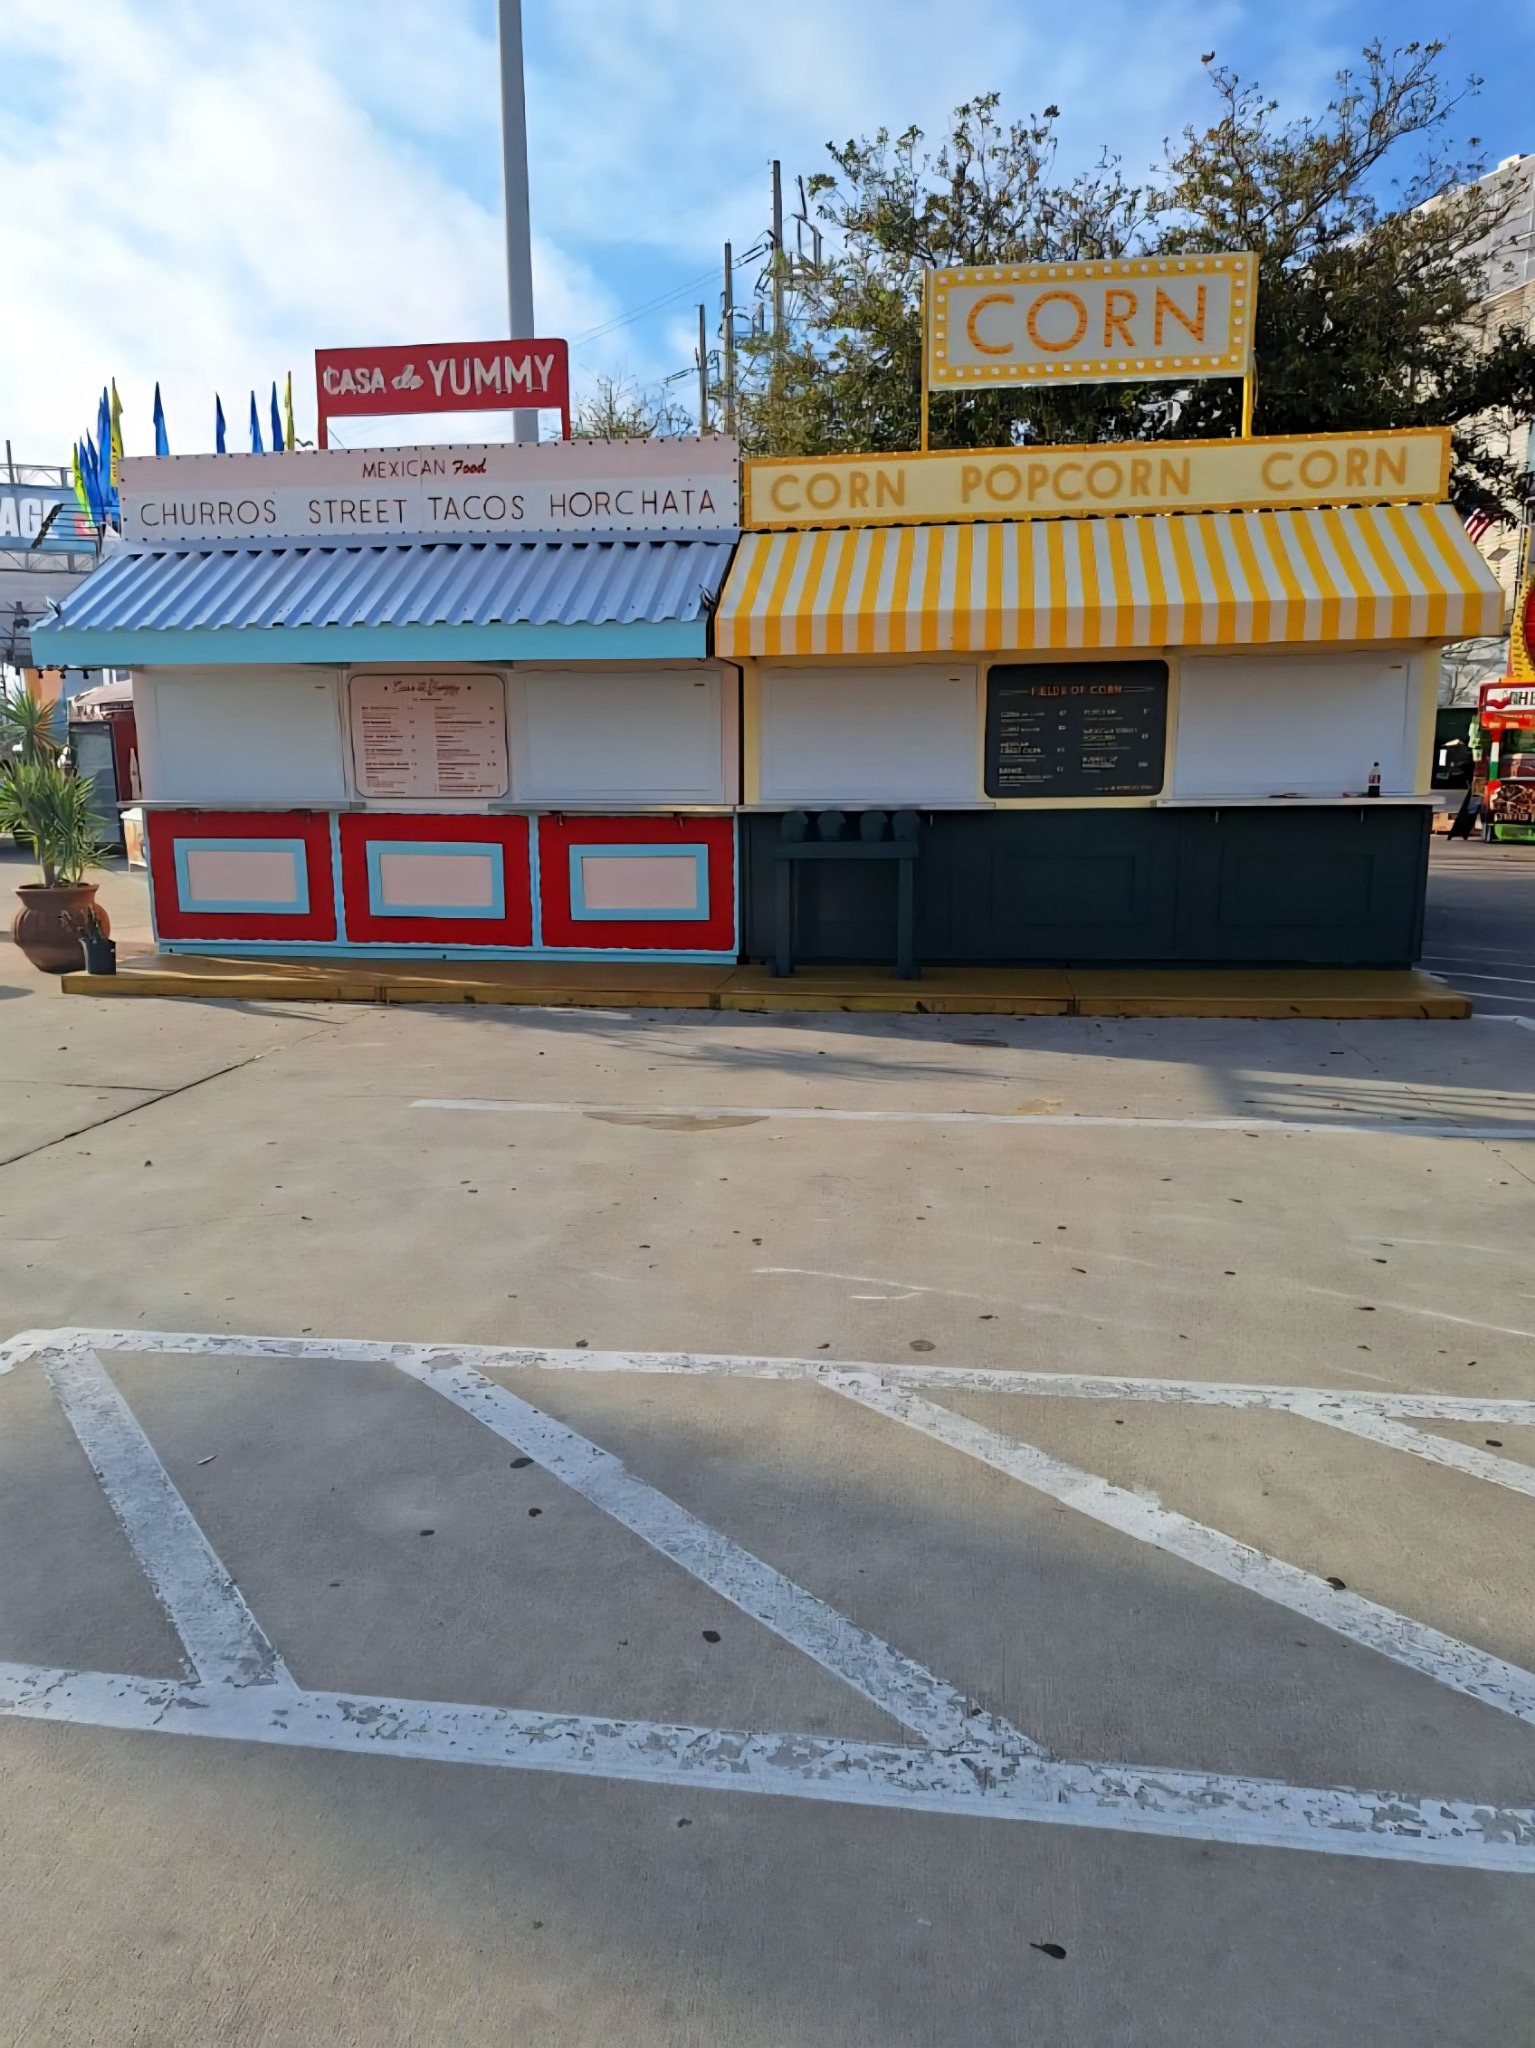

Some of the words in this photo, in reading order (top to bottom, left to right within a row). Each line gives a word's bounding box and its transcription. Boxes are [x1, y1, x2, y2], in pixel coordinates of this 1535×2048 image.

[967, 284, 1206, 355] CORN
[323, 351, 387, 395] CASA
[427, 354, 555, 397] YUMMY
[362, 459, 446, 478] MEXICAN
[452, 457, 487, 475] Food
[770, 469, 906, 513] CORN
[961, 457, 1191, 504] POPCORN
[1261, 446, 1408, 492] CORN
[140, 499, 277, 526] CHURROS
[308, 499, 407, 524] STREET
[427, 495, 525, 521] TACOS
[549, 489, 716, 518] HORCHATA
